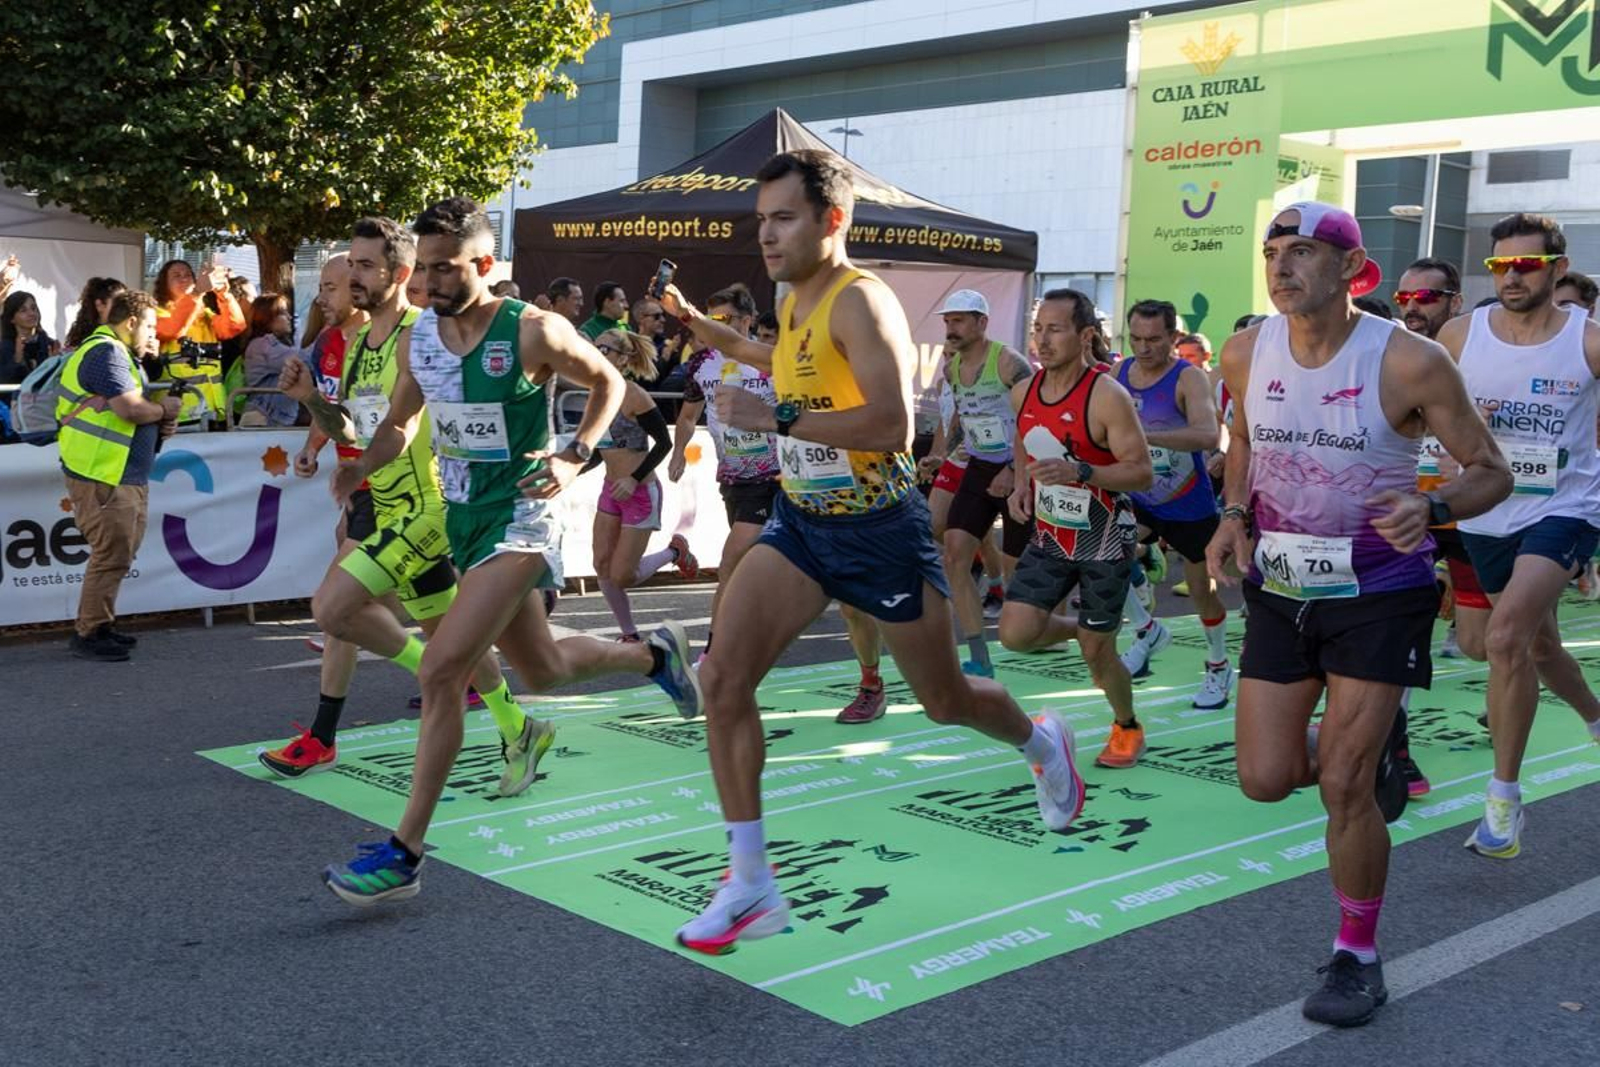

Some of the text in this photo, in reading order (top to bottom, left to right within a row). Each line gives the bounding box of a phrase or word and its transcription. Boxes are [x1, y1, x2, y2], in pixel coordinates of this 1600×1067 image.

[1152, 76, 1265, 103] CAJA RURAL
[1181, 100, 1229, 122] JAÉN
[1145, 137, 1261, 162] calderón
[552, 215, 733, 241] www.evedeport.es
[1153, 224, 1244, 241] Ayuntamiento
[849, 224, 1003, 253] ww.evedeport.es
[1172, 239, 1223, 252] de Jaén
[370, 412, 378, 424] 3
[464, 422, 498, 435] 424
[984, 429, 992, 438] 2
[1296, 432, 1309, 442] DE
[1307, 429, 1366, 451] SEGURA
[805, 448, 839, 462] 506
[1511, 461, 1547, 475] 598
[1059, 499, 1082, 513] 264
[1304, 558, 1334, 574] 70
[13, 576, 28, 587] te
[31, 571, 62, 585] está
[547, 811, 680, 845] TEAMERGY
[1109, 886, 1230, 912] TEAMERGY
[908, 925, 1053, 980] TEAMERGY
